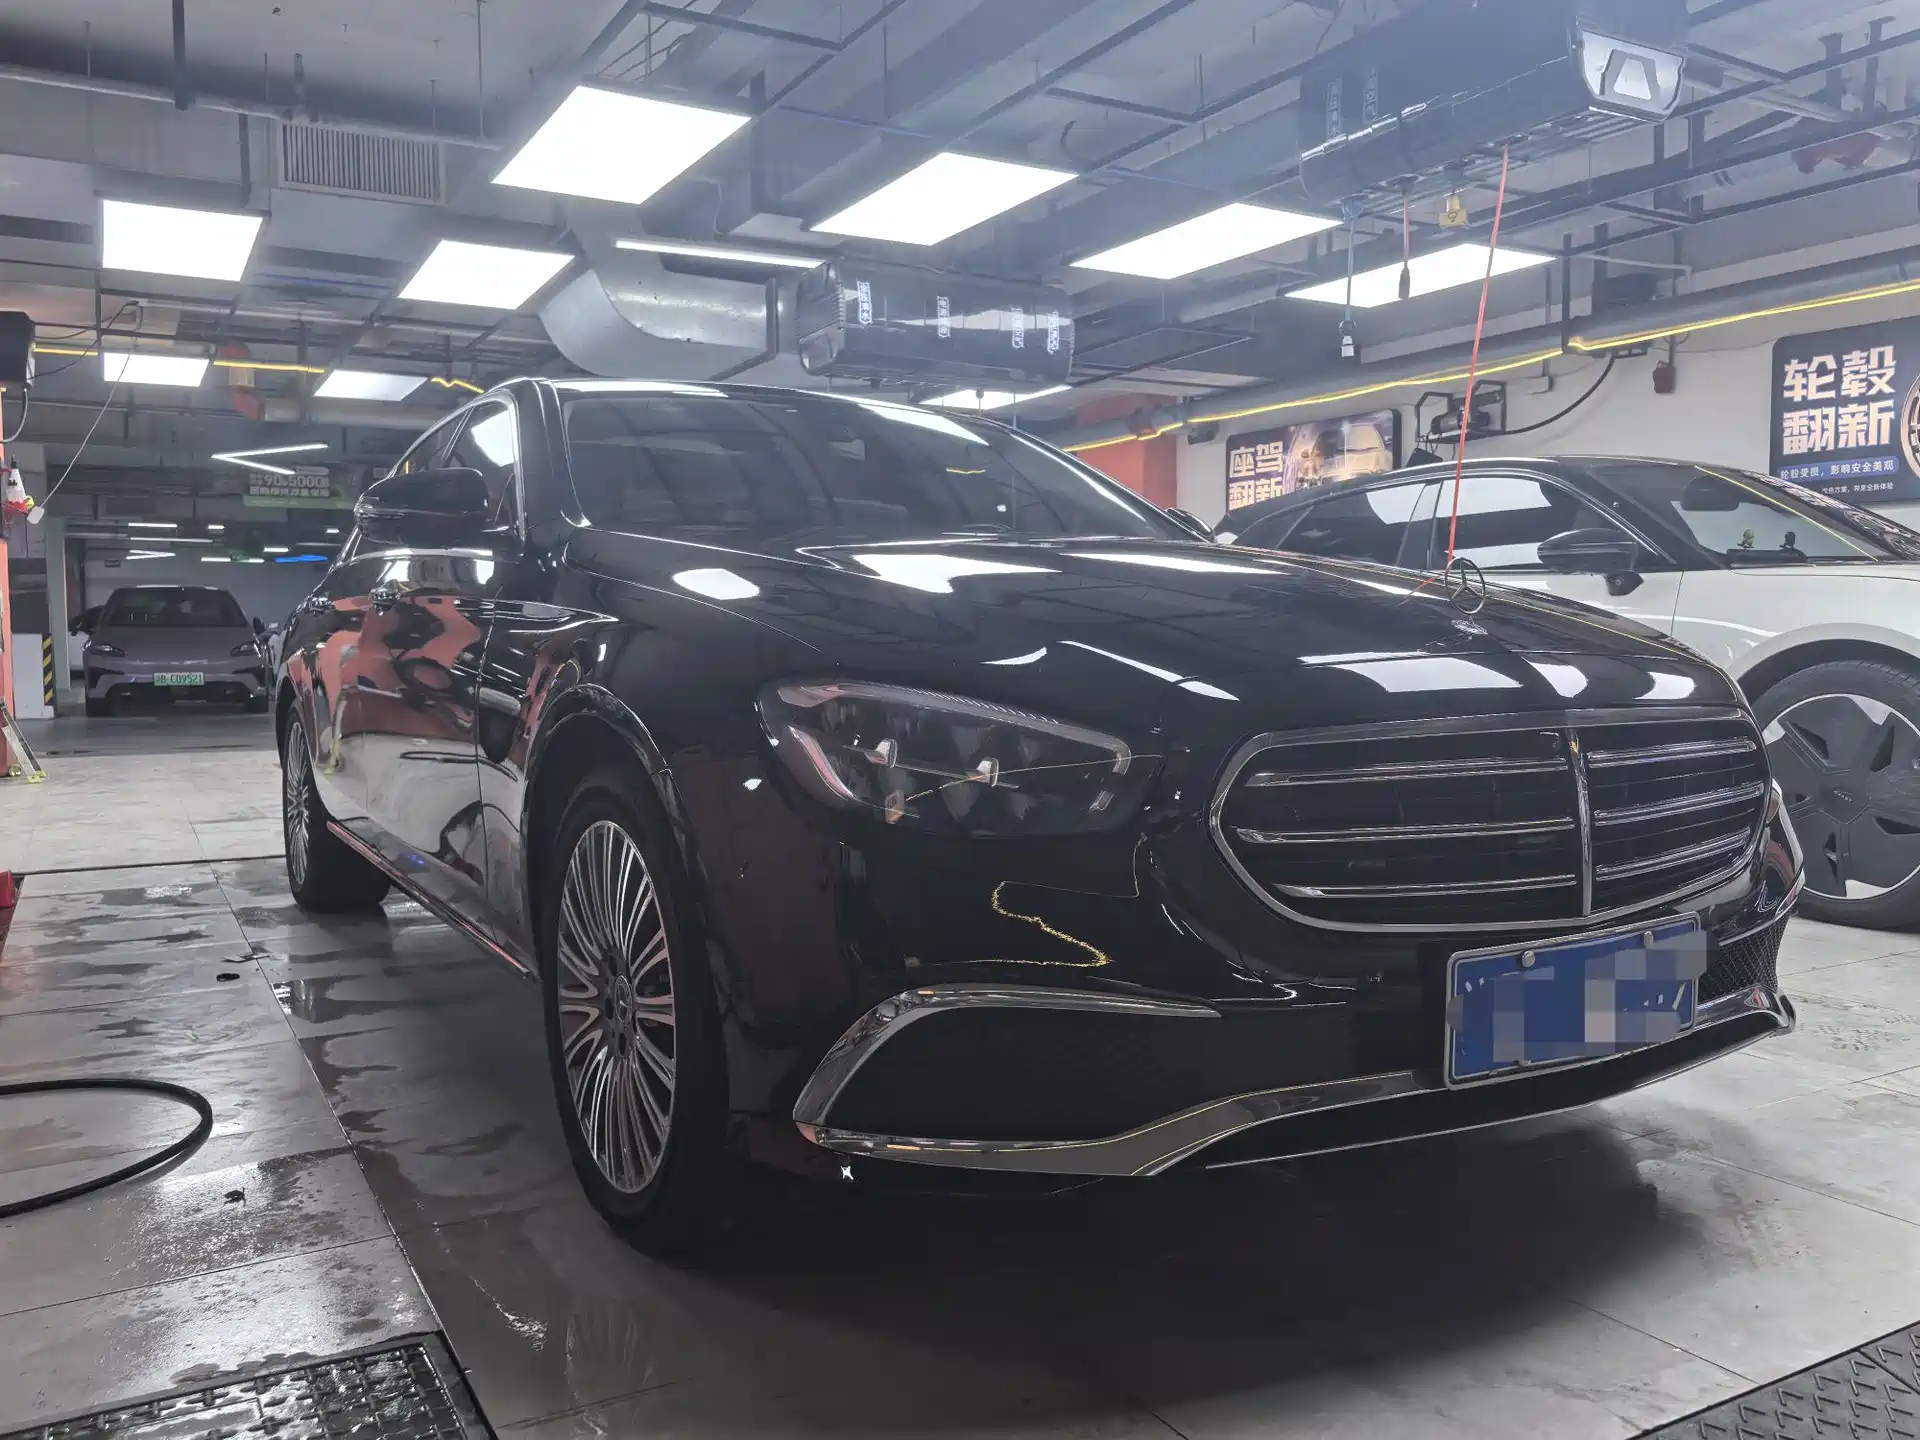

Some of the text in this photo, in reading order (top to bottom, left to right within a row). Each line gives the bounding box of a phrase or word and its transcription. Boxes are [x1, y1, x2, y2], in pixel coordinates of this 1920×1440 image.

[1783, 345, 1896, 402] 轮毂
[1782, 399, 1895, 455] 翻新
[1229, 441, 1284, 478] 座驾
[1228, 476, 1284, 511] 翻新
